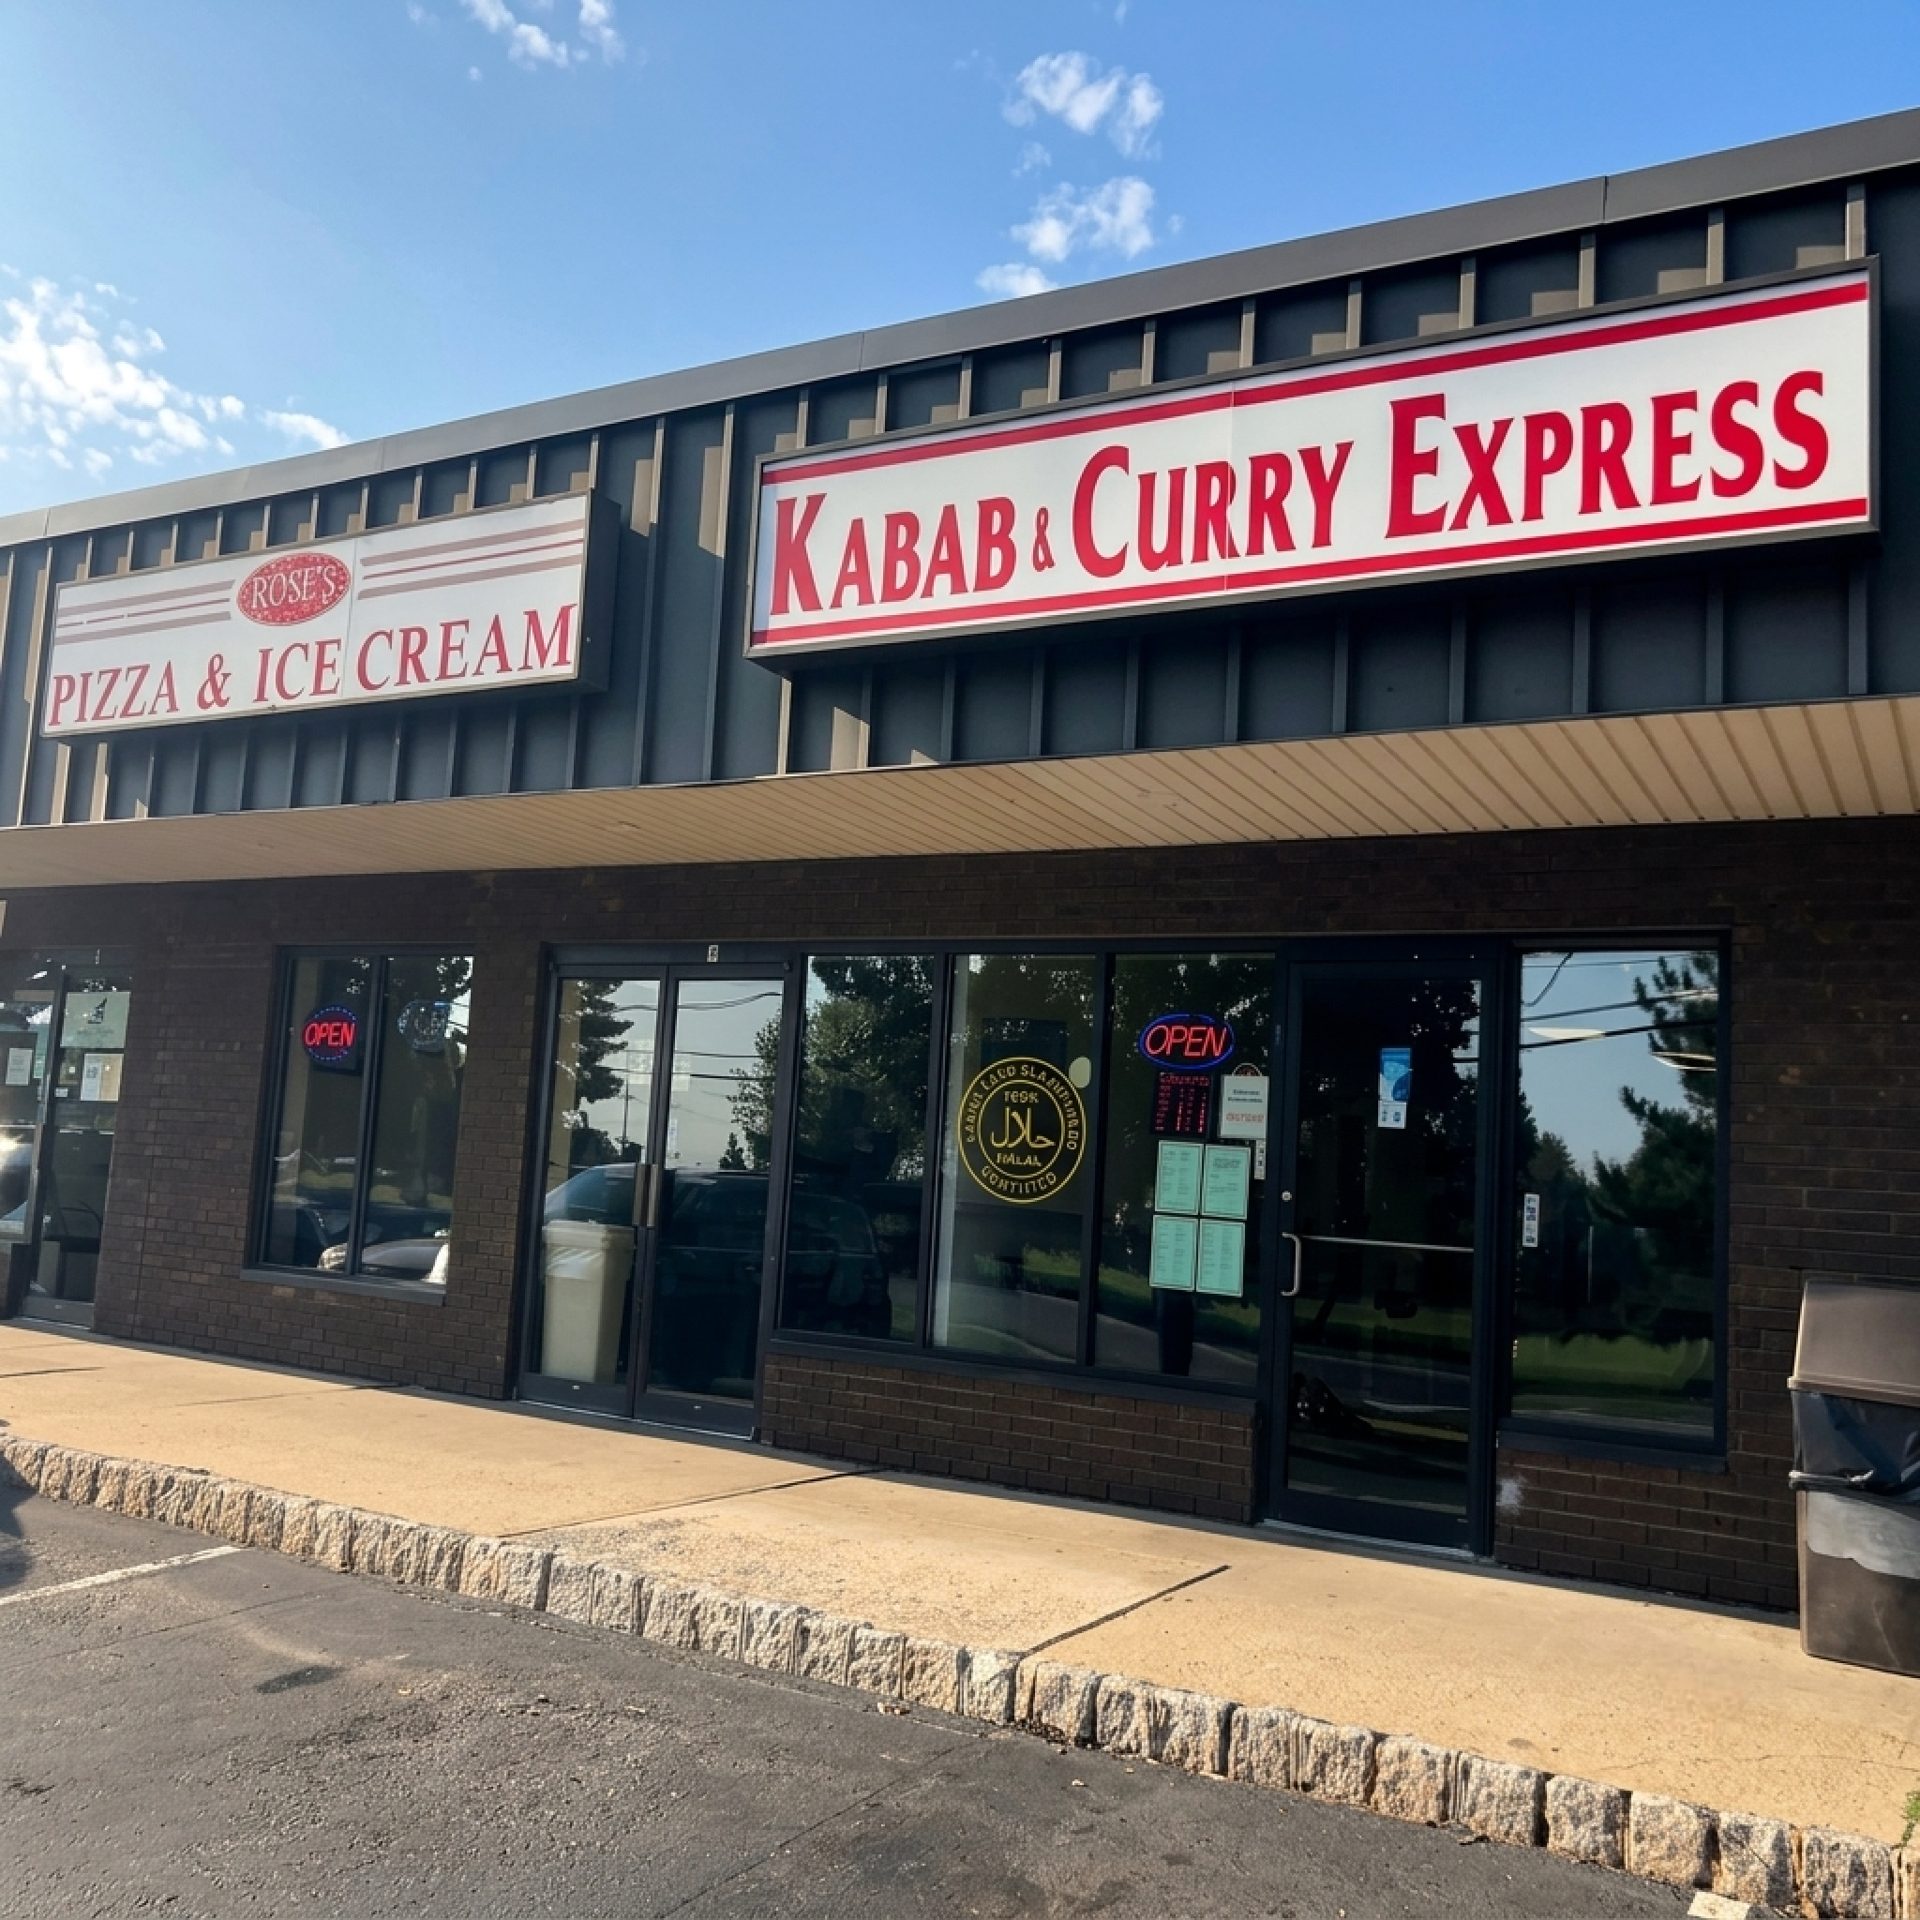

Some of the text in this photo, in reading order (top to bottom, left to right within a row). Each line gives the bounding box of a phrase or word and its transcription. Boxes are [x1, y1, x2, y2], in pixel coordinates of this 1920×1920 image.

[770, 370, 1829, 616] KABAB & CURRY EXPRESS
[251, 565, 336, 609] ROSE'S
[48, 603, 578, 727] PIZZA & ICE CREAM
[304, 1021, 356, 1047] OPEN
[1145, 1024, 1228, 1057] OPEN
